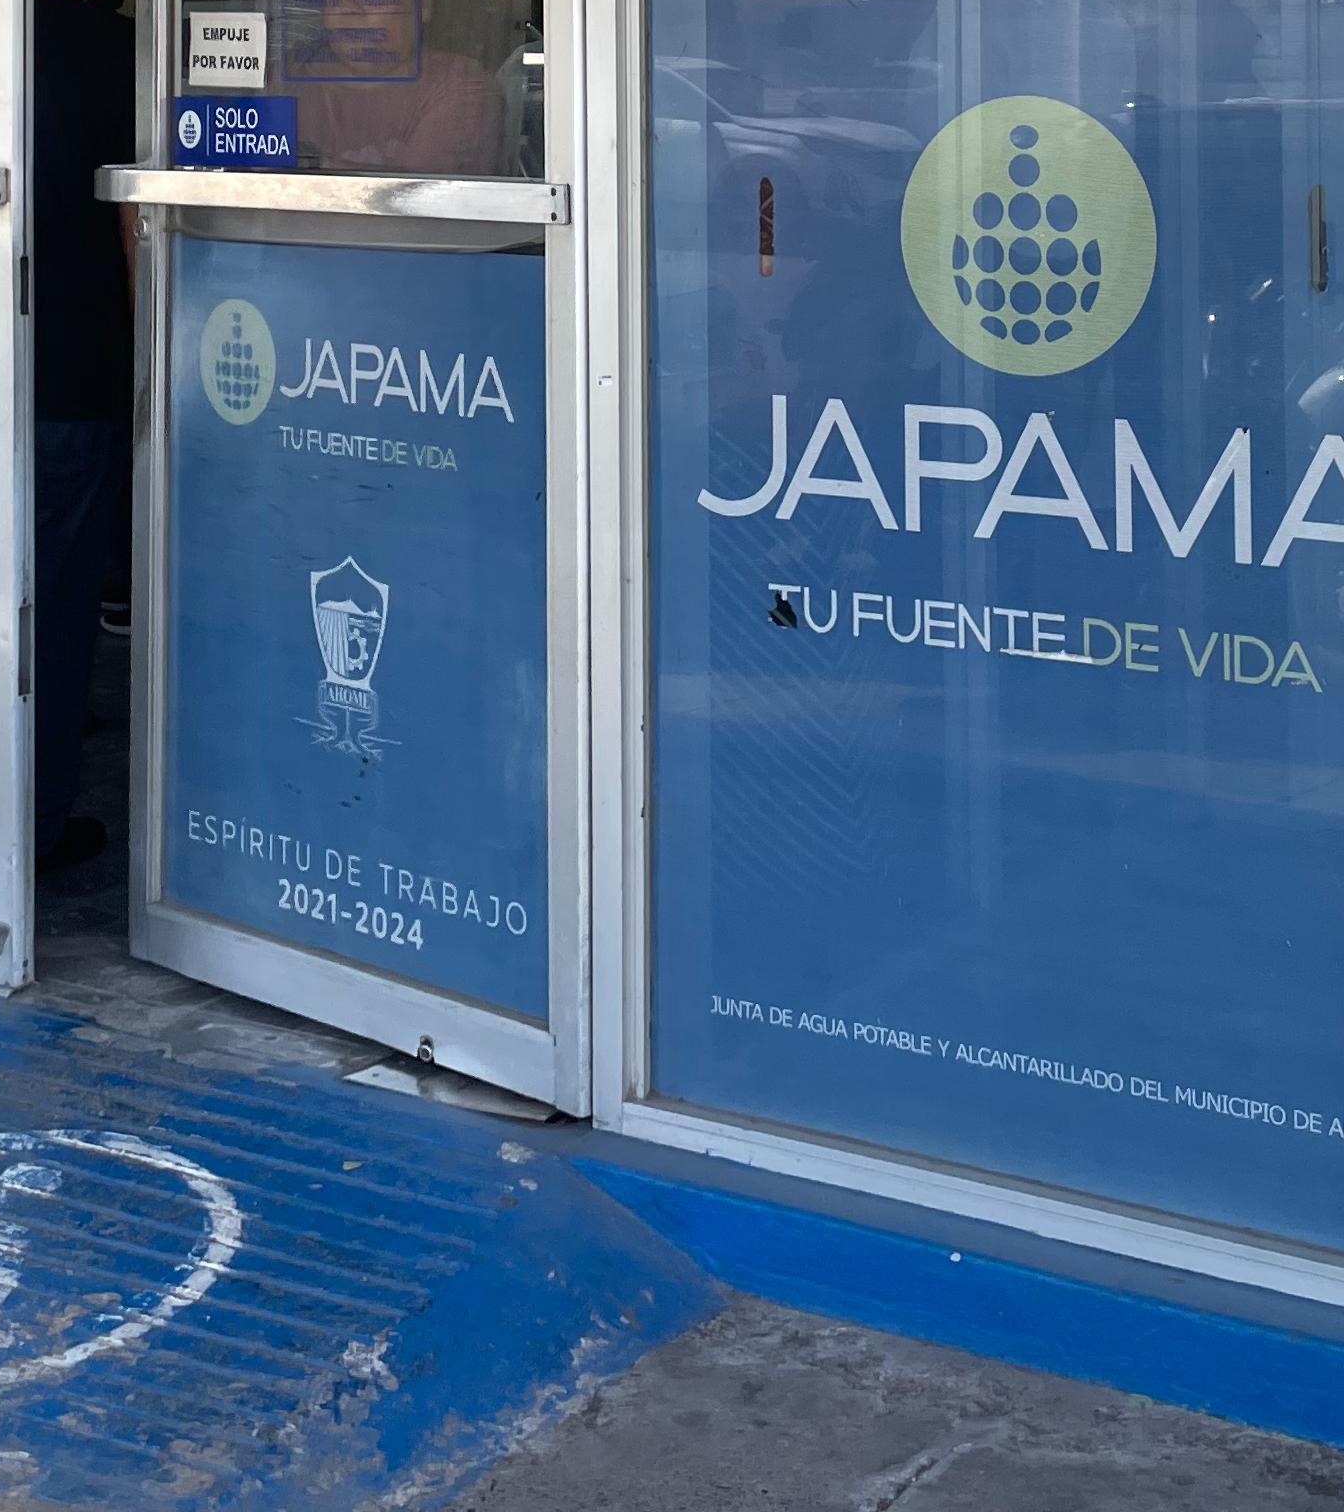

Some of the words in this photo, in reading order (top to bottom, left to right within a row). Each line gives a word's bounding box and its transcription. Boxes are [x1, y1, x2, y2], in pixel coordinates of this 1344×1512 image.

[192, 54, 216, 69] POR
[220, 55, 259, 70] FAVOR
[203, 27, 249, 42] EMPUJE
[215, 108, 258, 129] SOLO
[215, 131, 290, 156] ENTRADA
[279, 337, 514, 424] JAPAMA
[279, 426, 304, 451] TU
[306, 429, 379, 461] FUENTE
[381, 438, 407, 465] DE
[412, 443, 457, 472] VIDA
[768, 583, 838, 634] TU
[852, 592, 1067, 655] FUENTE
[1083, 617, 1160, 673] DE
[1178, 626, 1323, 693] VIDA
[187, 809, 311, 872] ESPÍRITU
[325, 849, 362, 886] DE
[378, 862, 528, 937] TRABAJO
[278, 878, 424, 950] 2021-2024
[711, 995, 764, 1023] JUNTA
[770, 1006, 793, 1028] DE
[798, 1012, 848, 1039] AGUA
[853, 1021, 932, 1056] POTABLE
[937, 1038, 951, 1060] Y
[955, 1042, 1124, 1093] ALCANTARILLADO
[1130, 1077, 1169, 1103] DEL
[1174, 1085, 1287, 1125] MUNICIPIO
[1292, 1109, 1323, 1134] DE
